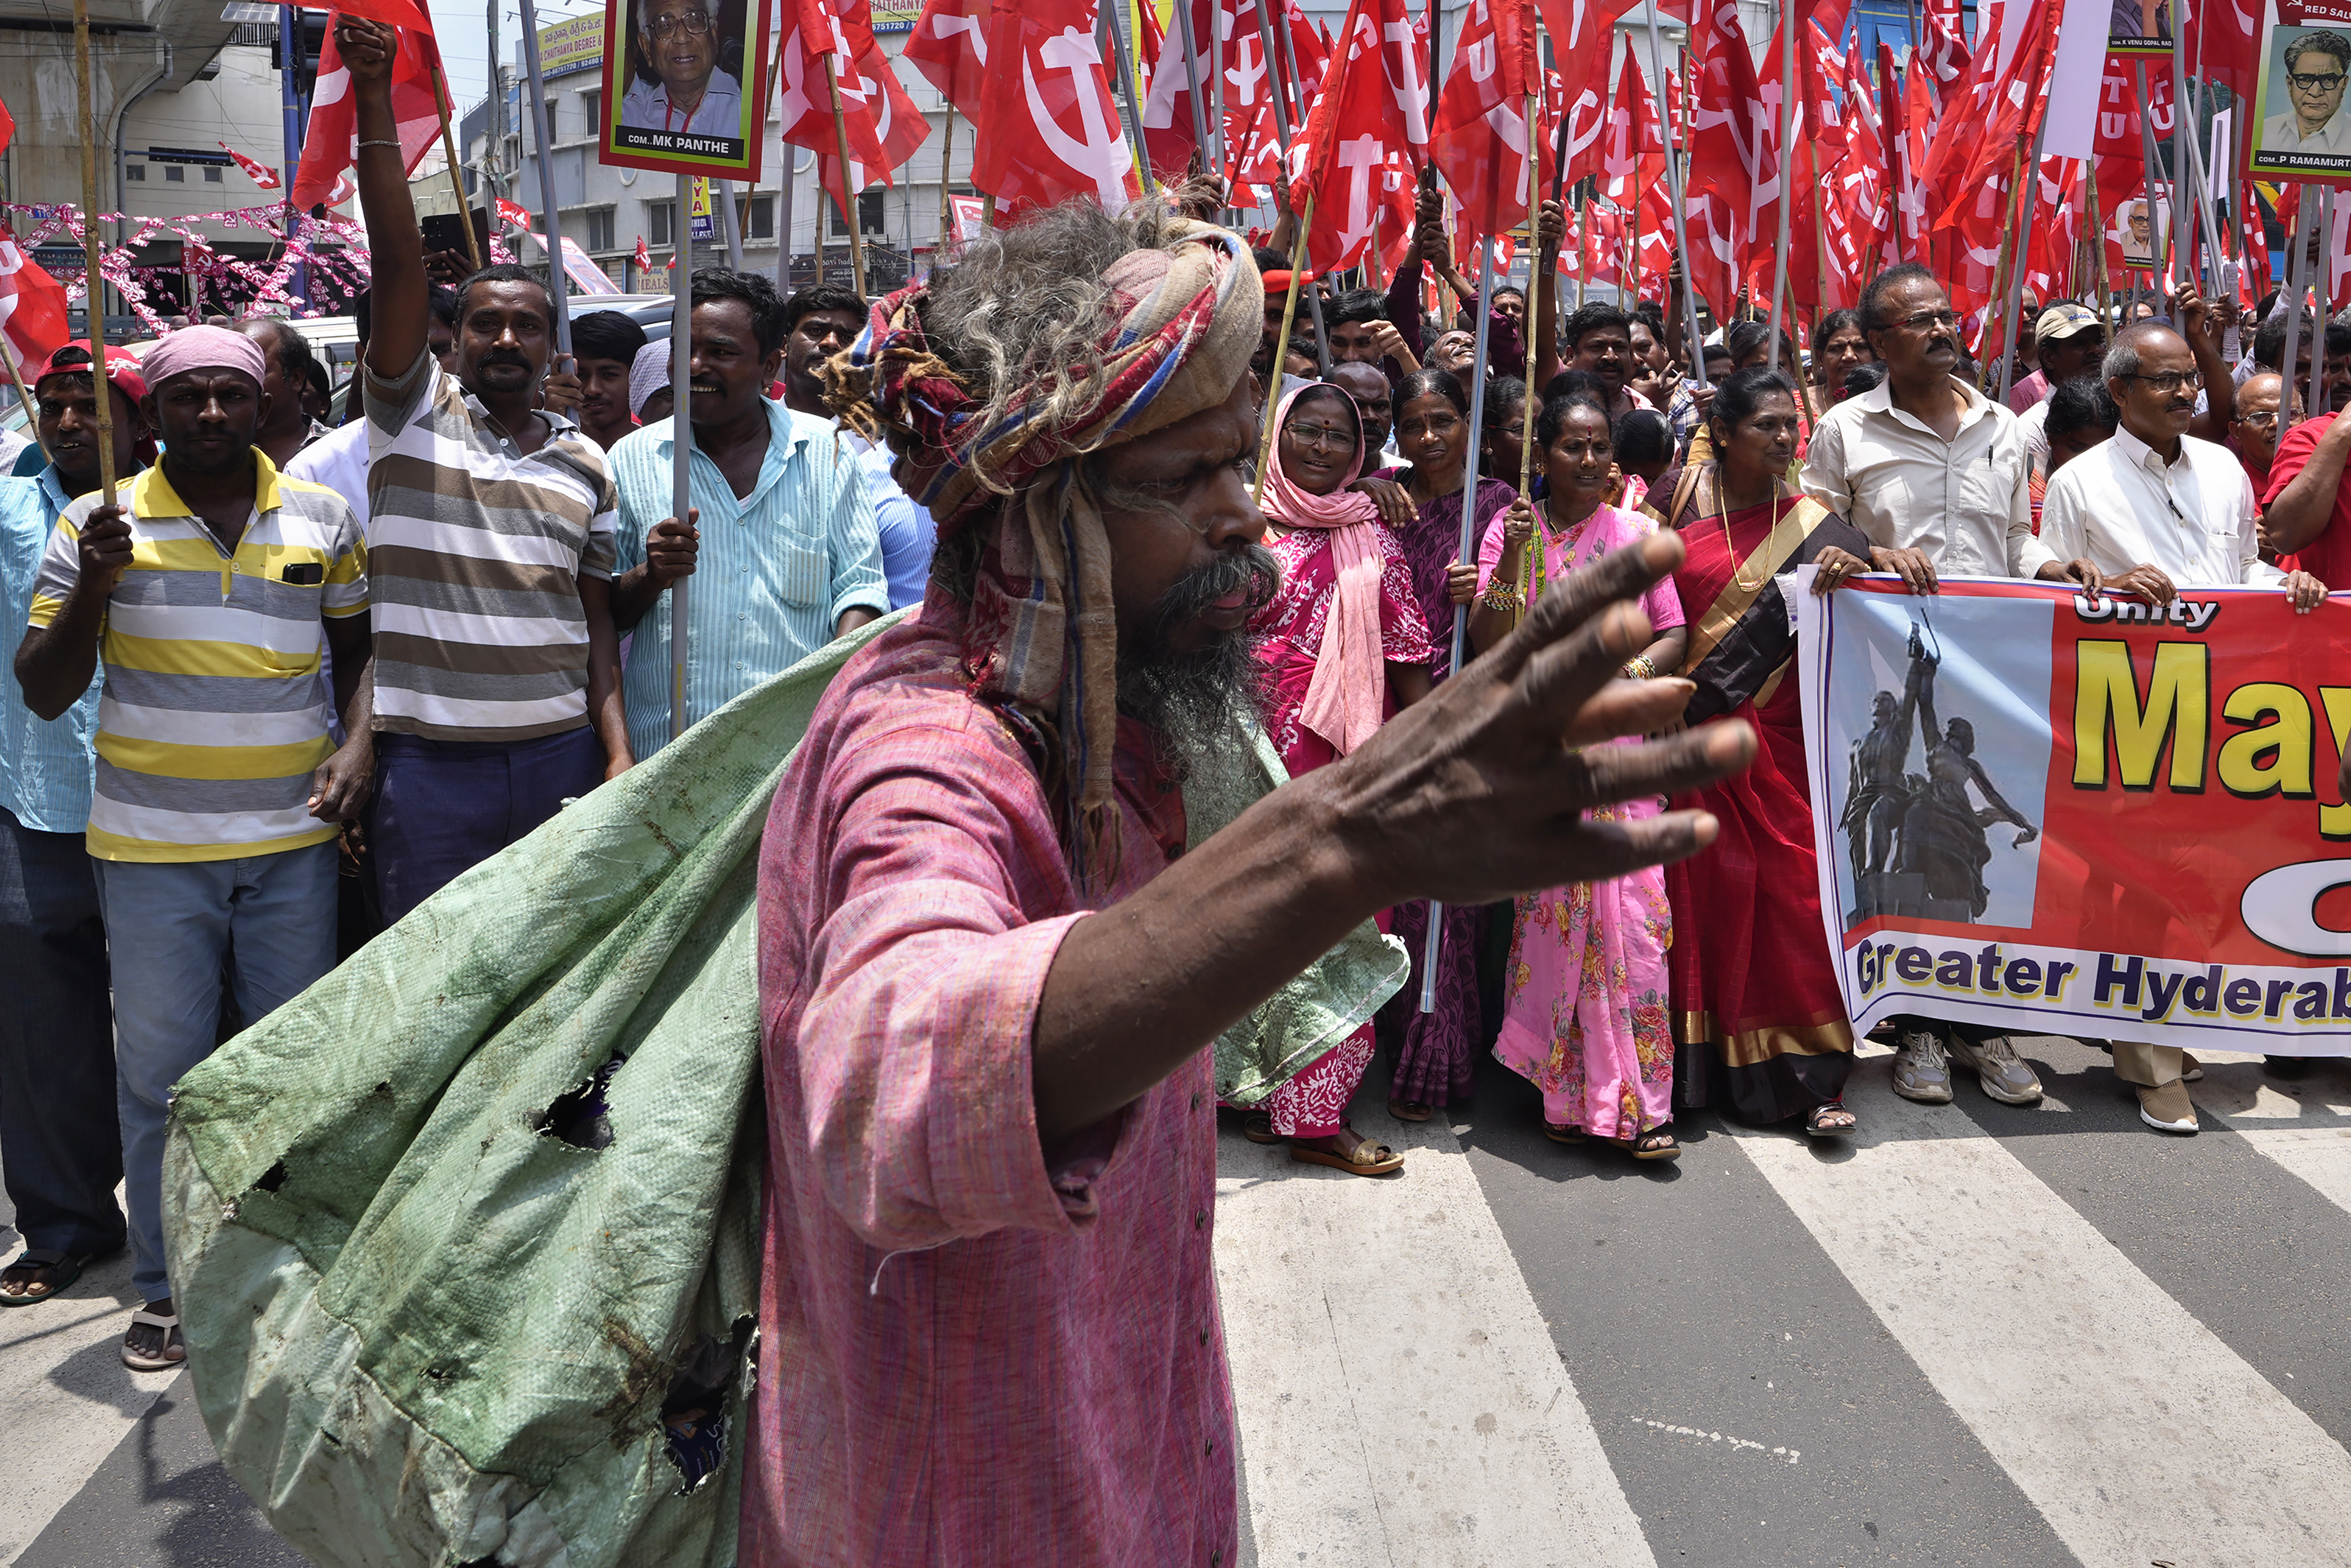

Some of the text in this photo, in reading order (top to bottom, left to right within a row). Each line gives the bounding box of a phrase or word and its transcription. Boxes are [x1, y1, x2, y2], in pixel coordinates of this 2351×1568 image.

[2305, 5, 2327, 14] RED
[544, 41, 574, 61] CHAITHANYA
[575, 35, 596, 52] DEGREE
[597, 34, 603, 46] &
[581, 57, 599, 67] 92480
[677, 137, 729, 154] PANTHE
[2290, 156, 2351, 168] RAMAMURT
[637, 277, 669, 291] MEALS
[2073, 594, 2218, 628] Unity
[1857, 939, 2074, 999] Greater
